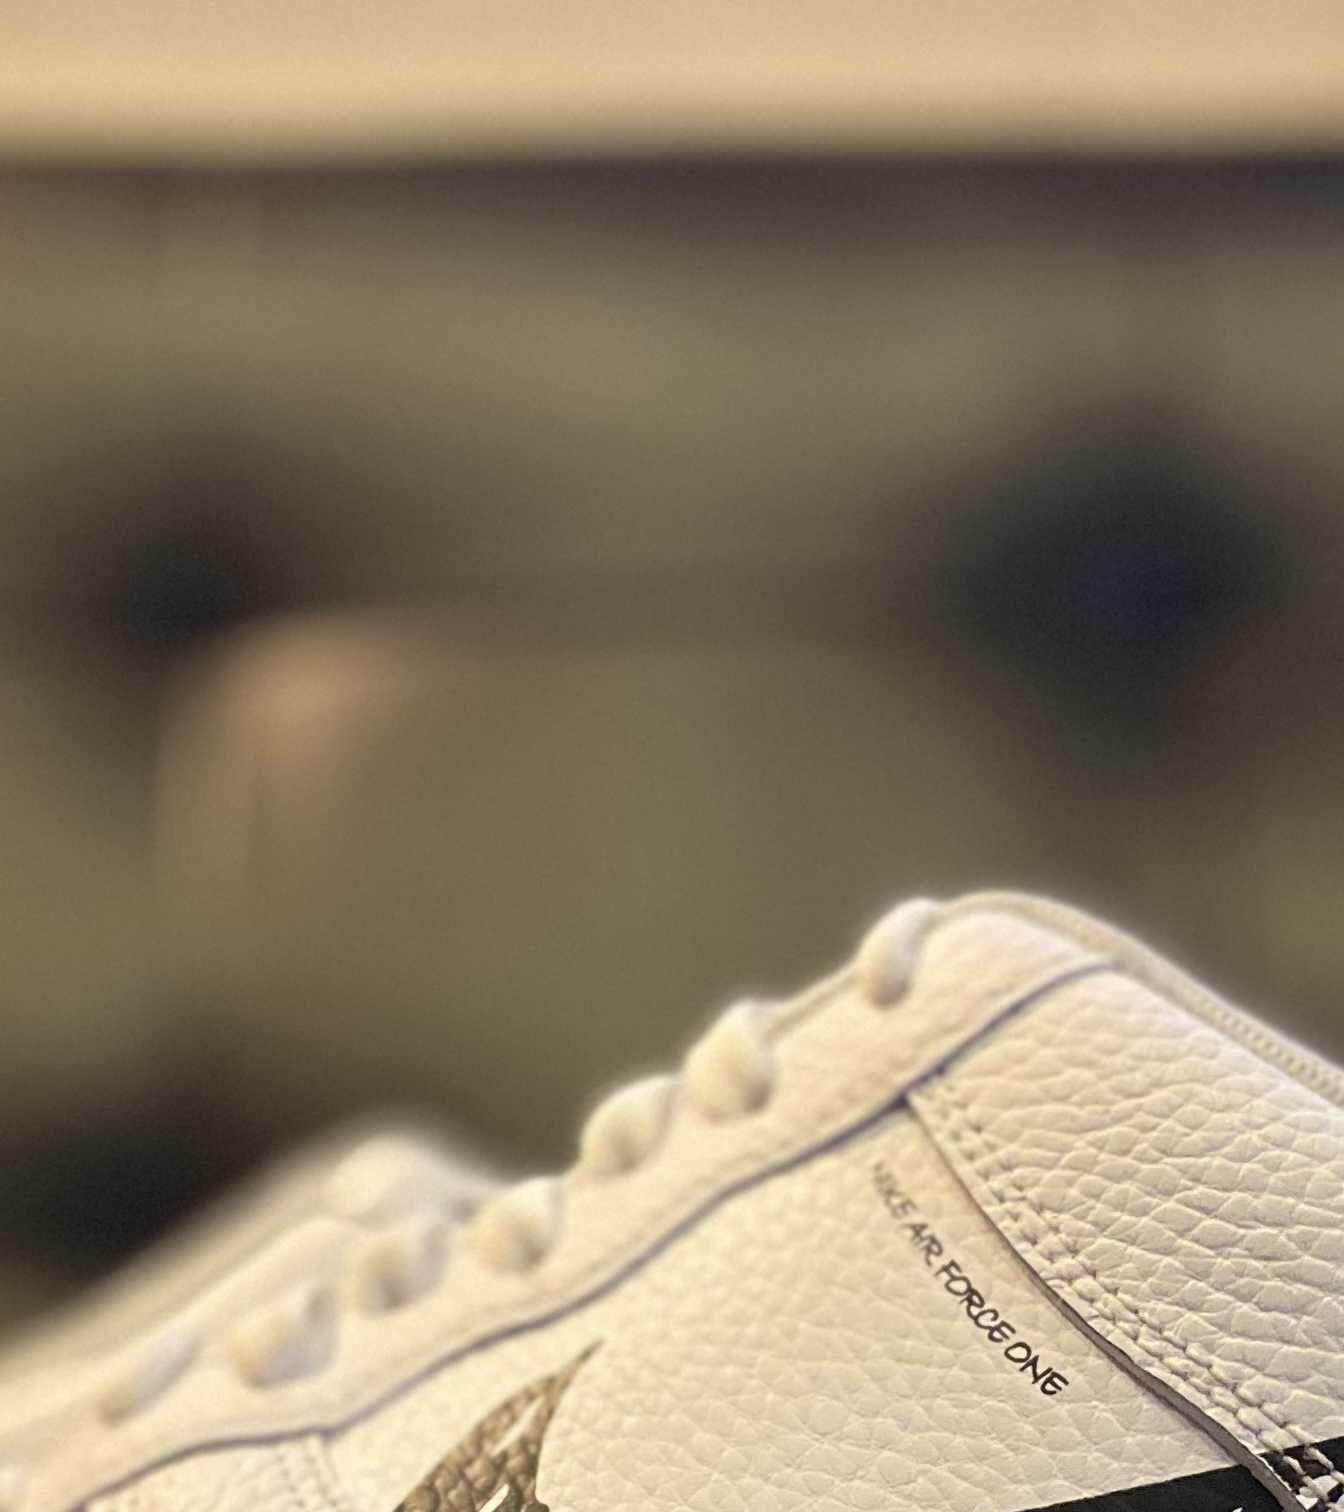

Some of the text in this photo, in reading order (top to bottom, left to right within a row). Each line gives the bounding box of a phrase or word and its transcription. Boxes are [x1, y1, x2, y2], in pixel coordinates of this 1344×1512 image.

[901, 1222, 944, 1266] AIR
[934, 1259, 1016, 1342] FORCE
[1004, 1342, 1069, 1395] ONE
